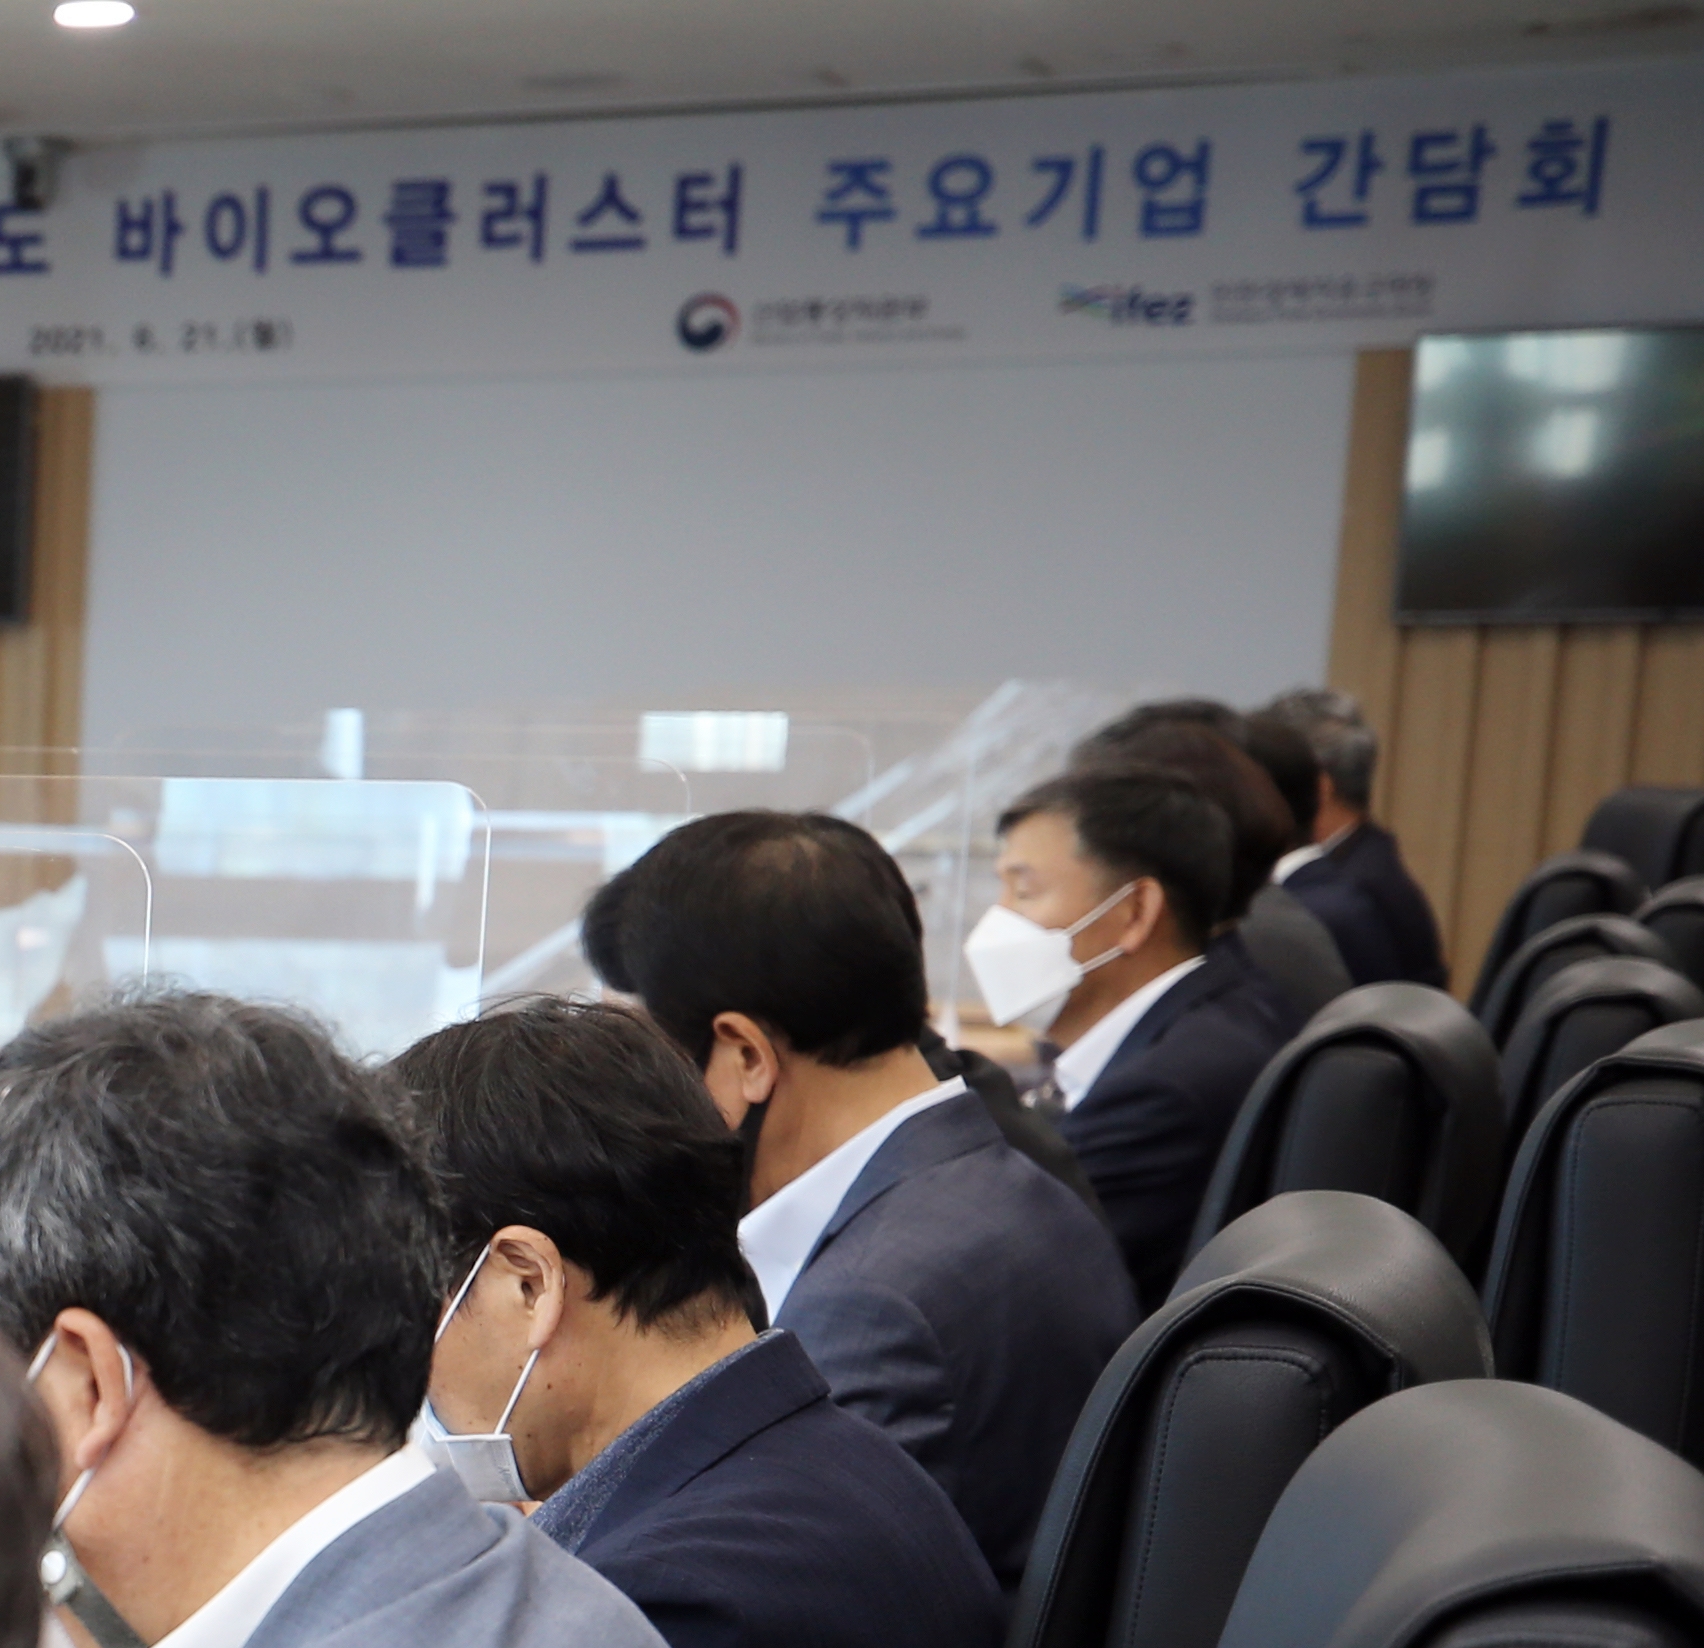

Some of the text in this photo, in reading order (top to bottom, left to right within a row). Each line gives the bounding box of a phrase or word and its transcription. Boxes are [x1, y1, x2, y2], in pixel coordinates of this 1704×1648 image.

[112, 164, 745, 276] 바이오클러스터
[815, 138, 1214, 250] 주요기업
[1293, 115, 1612, 230] 간담회
